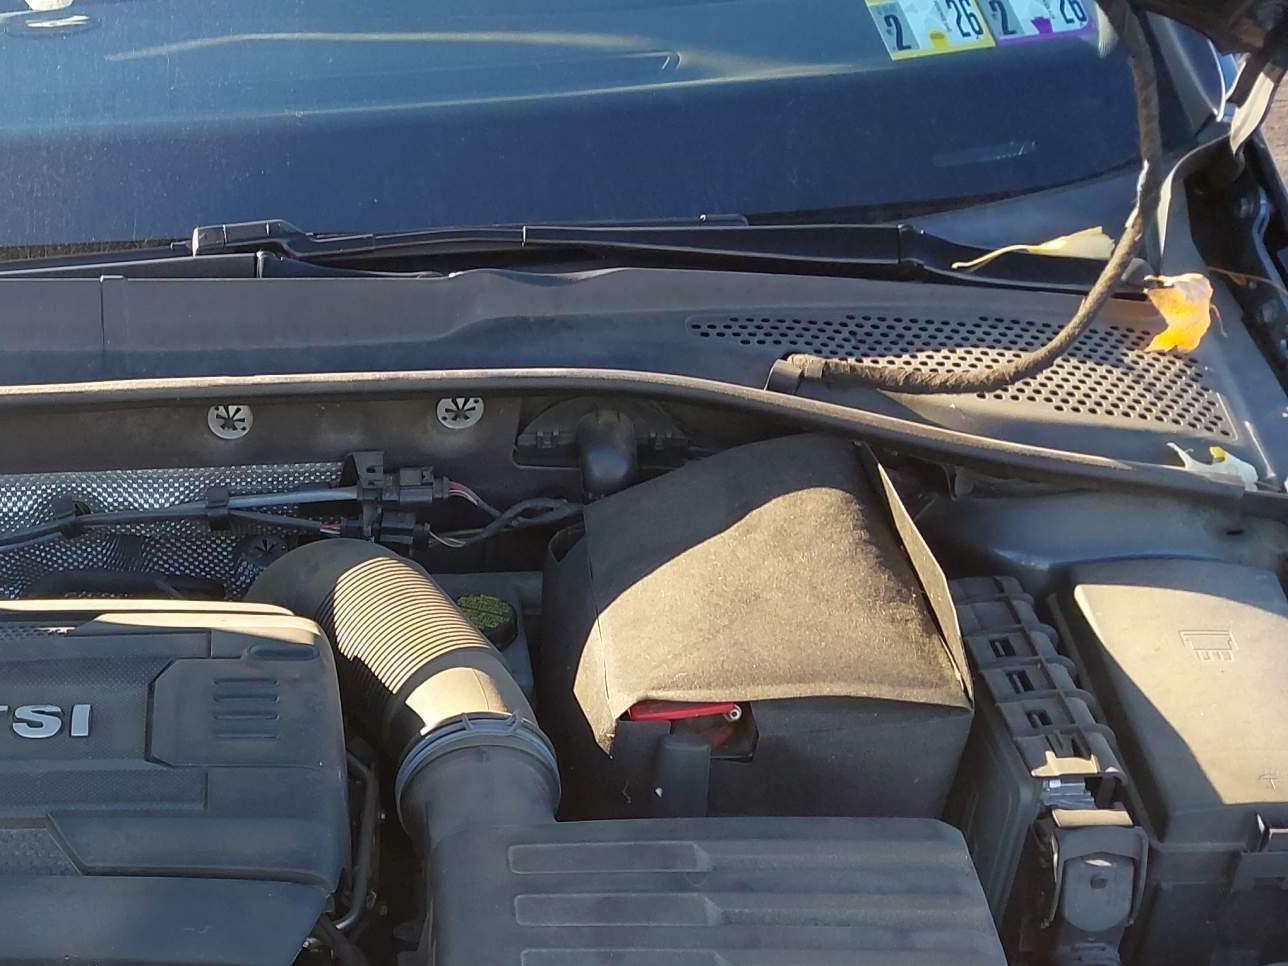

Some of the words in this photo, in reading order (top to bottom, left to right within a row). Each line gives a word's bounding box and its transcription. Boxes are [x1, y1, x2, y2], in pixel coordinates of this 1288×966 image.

[883, 13, 913, 51] 2
[945, 0, 984, 38] 26
[988, 0, 1017, 36] 2
